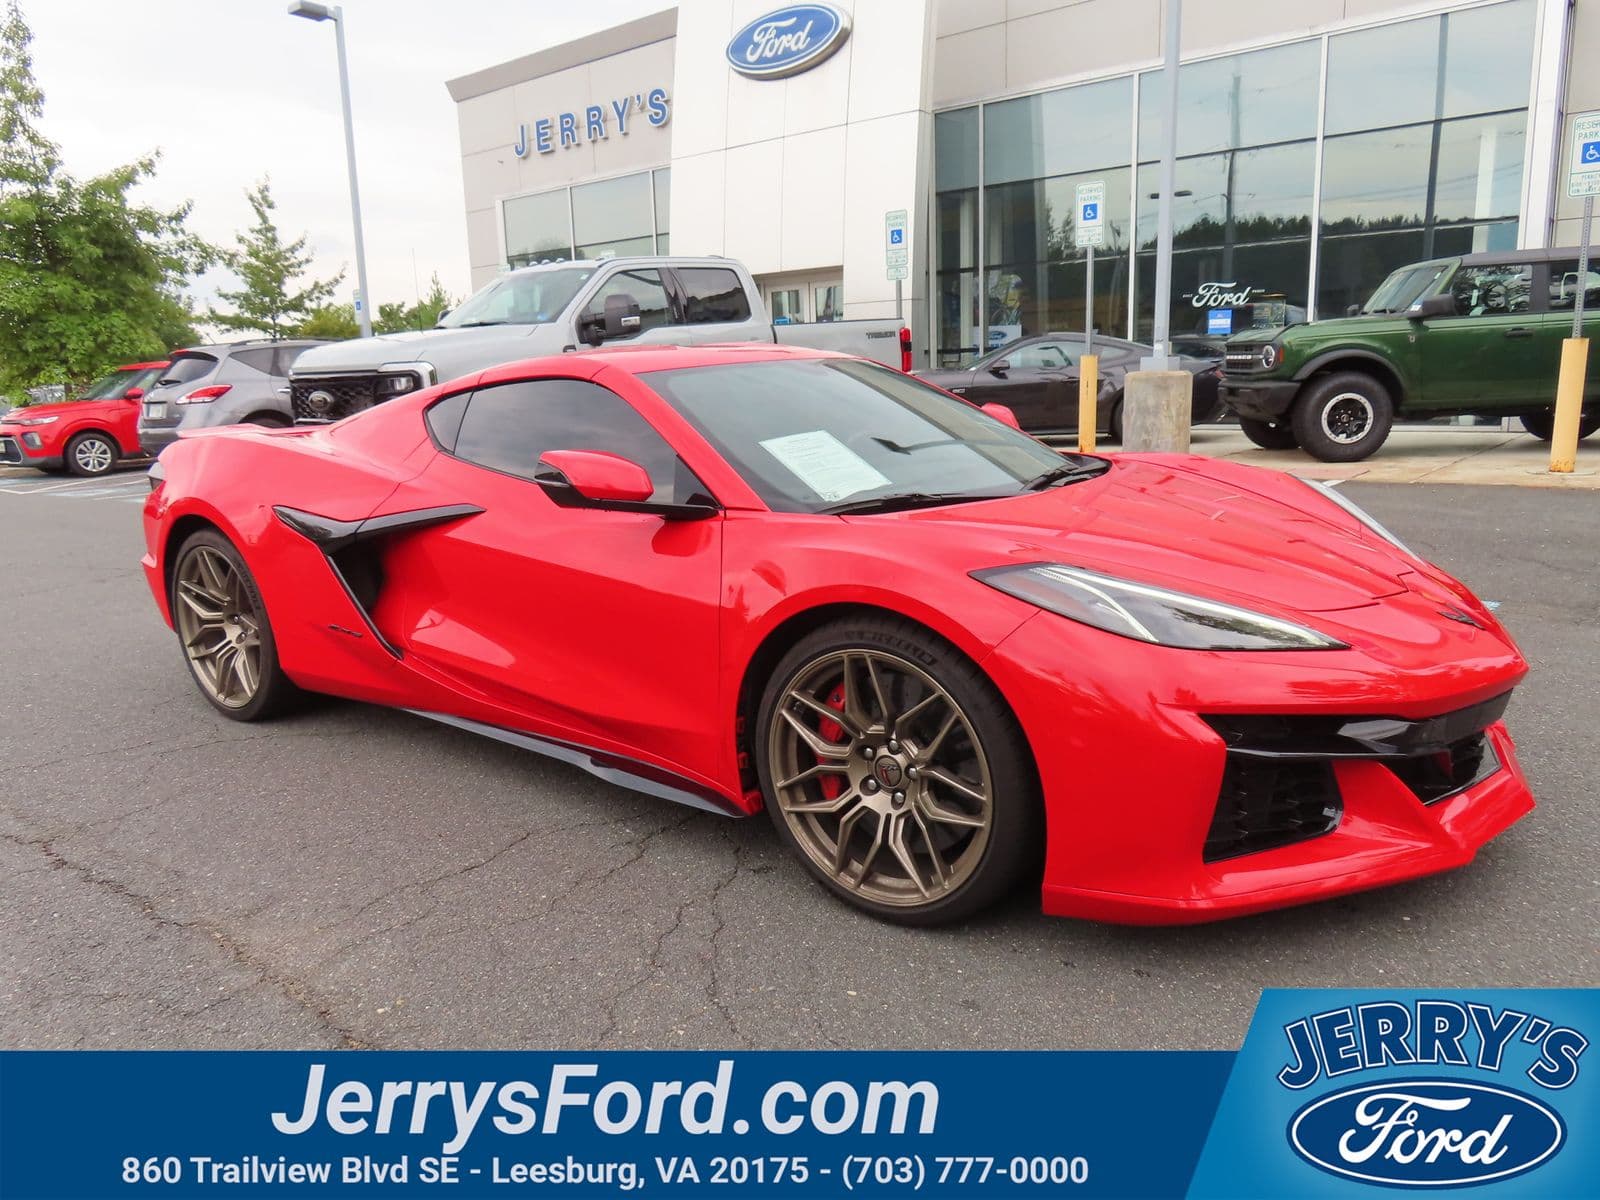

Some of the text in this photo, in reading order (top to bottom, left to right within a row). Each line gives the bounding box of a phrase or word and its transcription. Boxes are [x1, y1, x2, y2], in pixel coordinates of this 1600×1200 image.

[745, 17, 813, 63] Ford
[514, 88, 668, 158] JERRY'S
[1192, 282, 1252, 308] Ford
